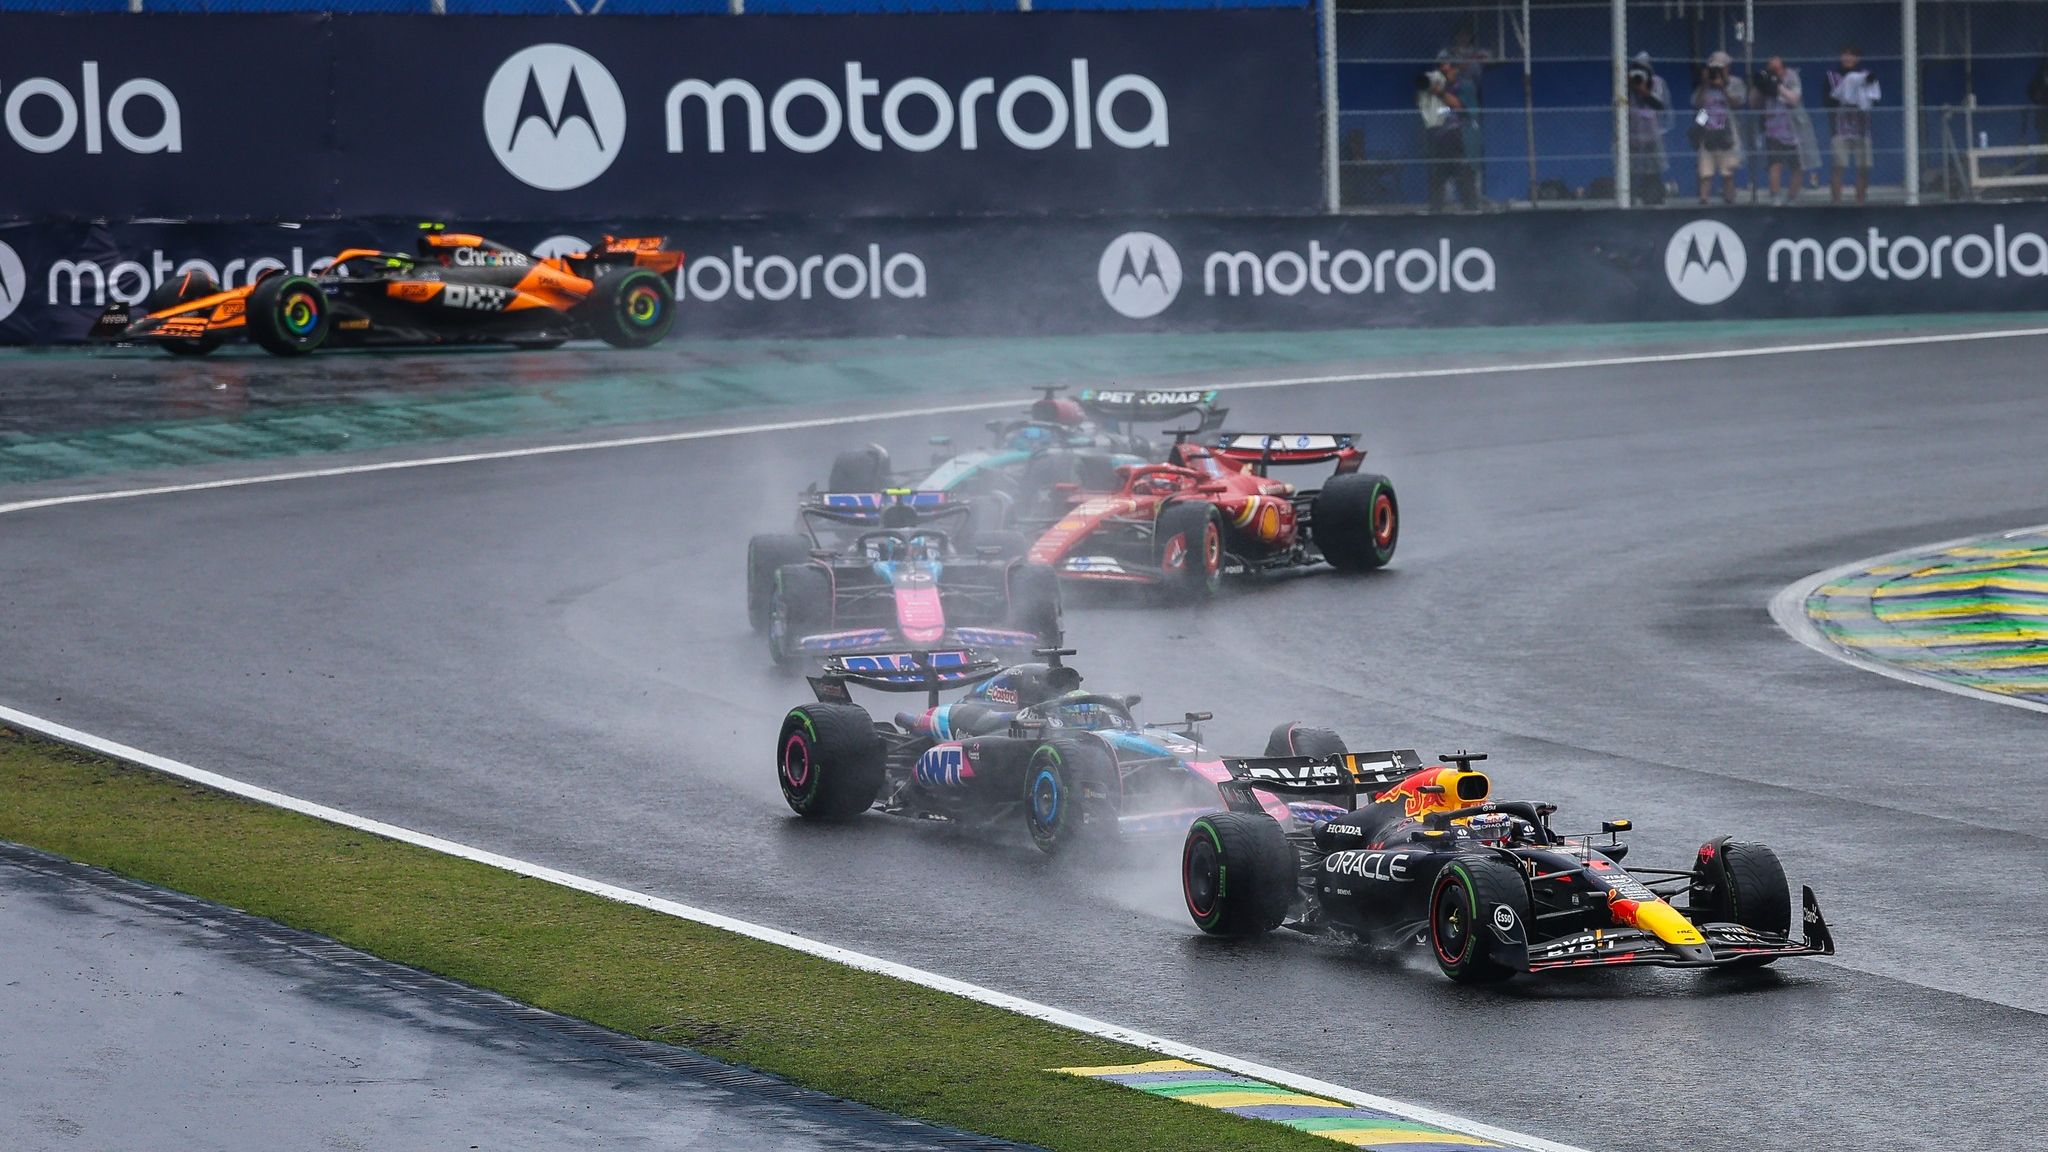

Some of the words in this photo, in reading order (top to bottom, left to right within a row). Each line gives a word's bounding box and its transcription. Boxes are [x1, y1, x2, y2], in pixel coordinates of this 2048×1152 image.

[0, 61, 182, 154] ola
[665, 58, 1170, 153] motorola
[454, 247, 528, 267] Chrome
[1204, 239, 1495, 296] motorola
[1767, 224, 2048, 282] motorola
[1097, 390, 1201, 404] PETONAS
[1326, 823, 1363, 837] HONDA
[1325, 850, 1415, 882] ORACLE
[1497, 908, 1512, 923] Esso
